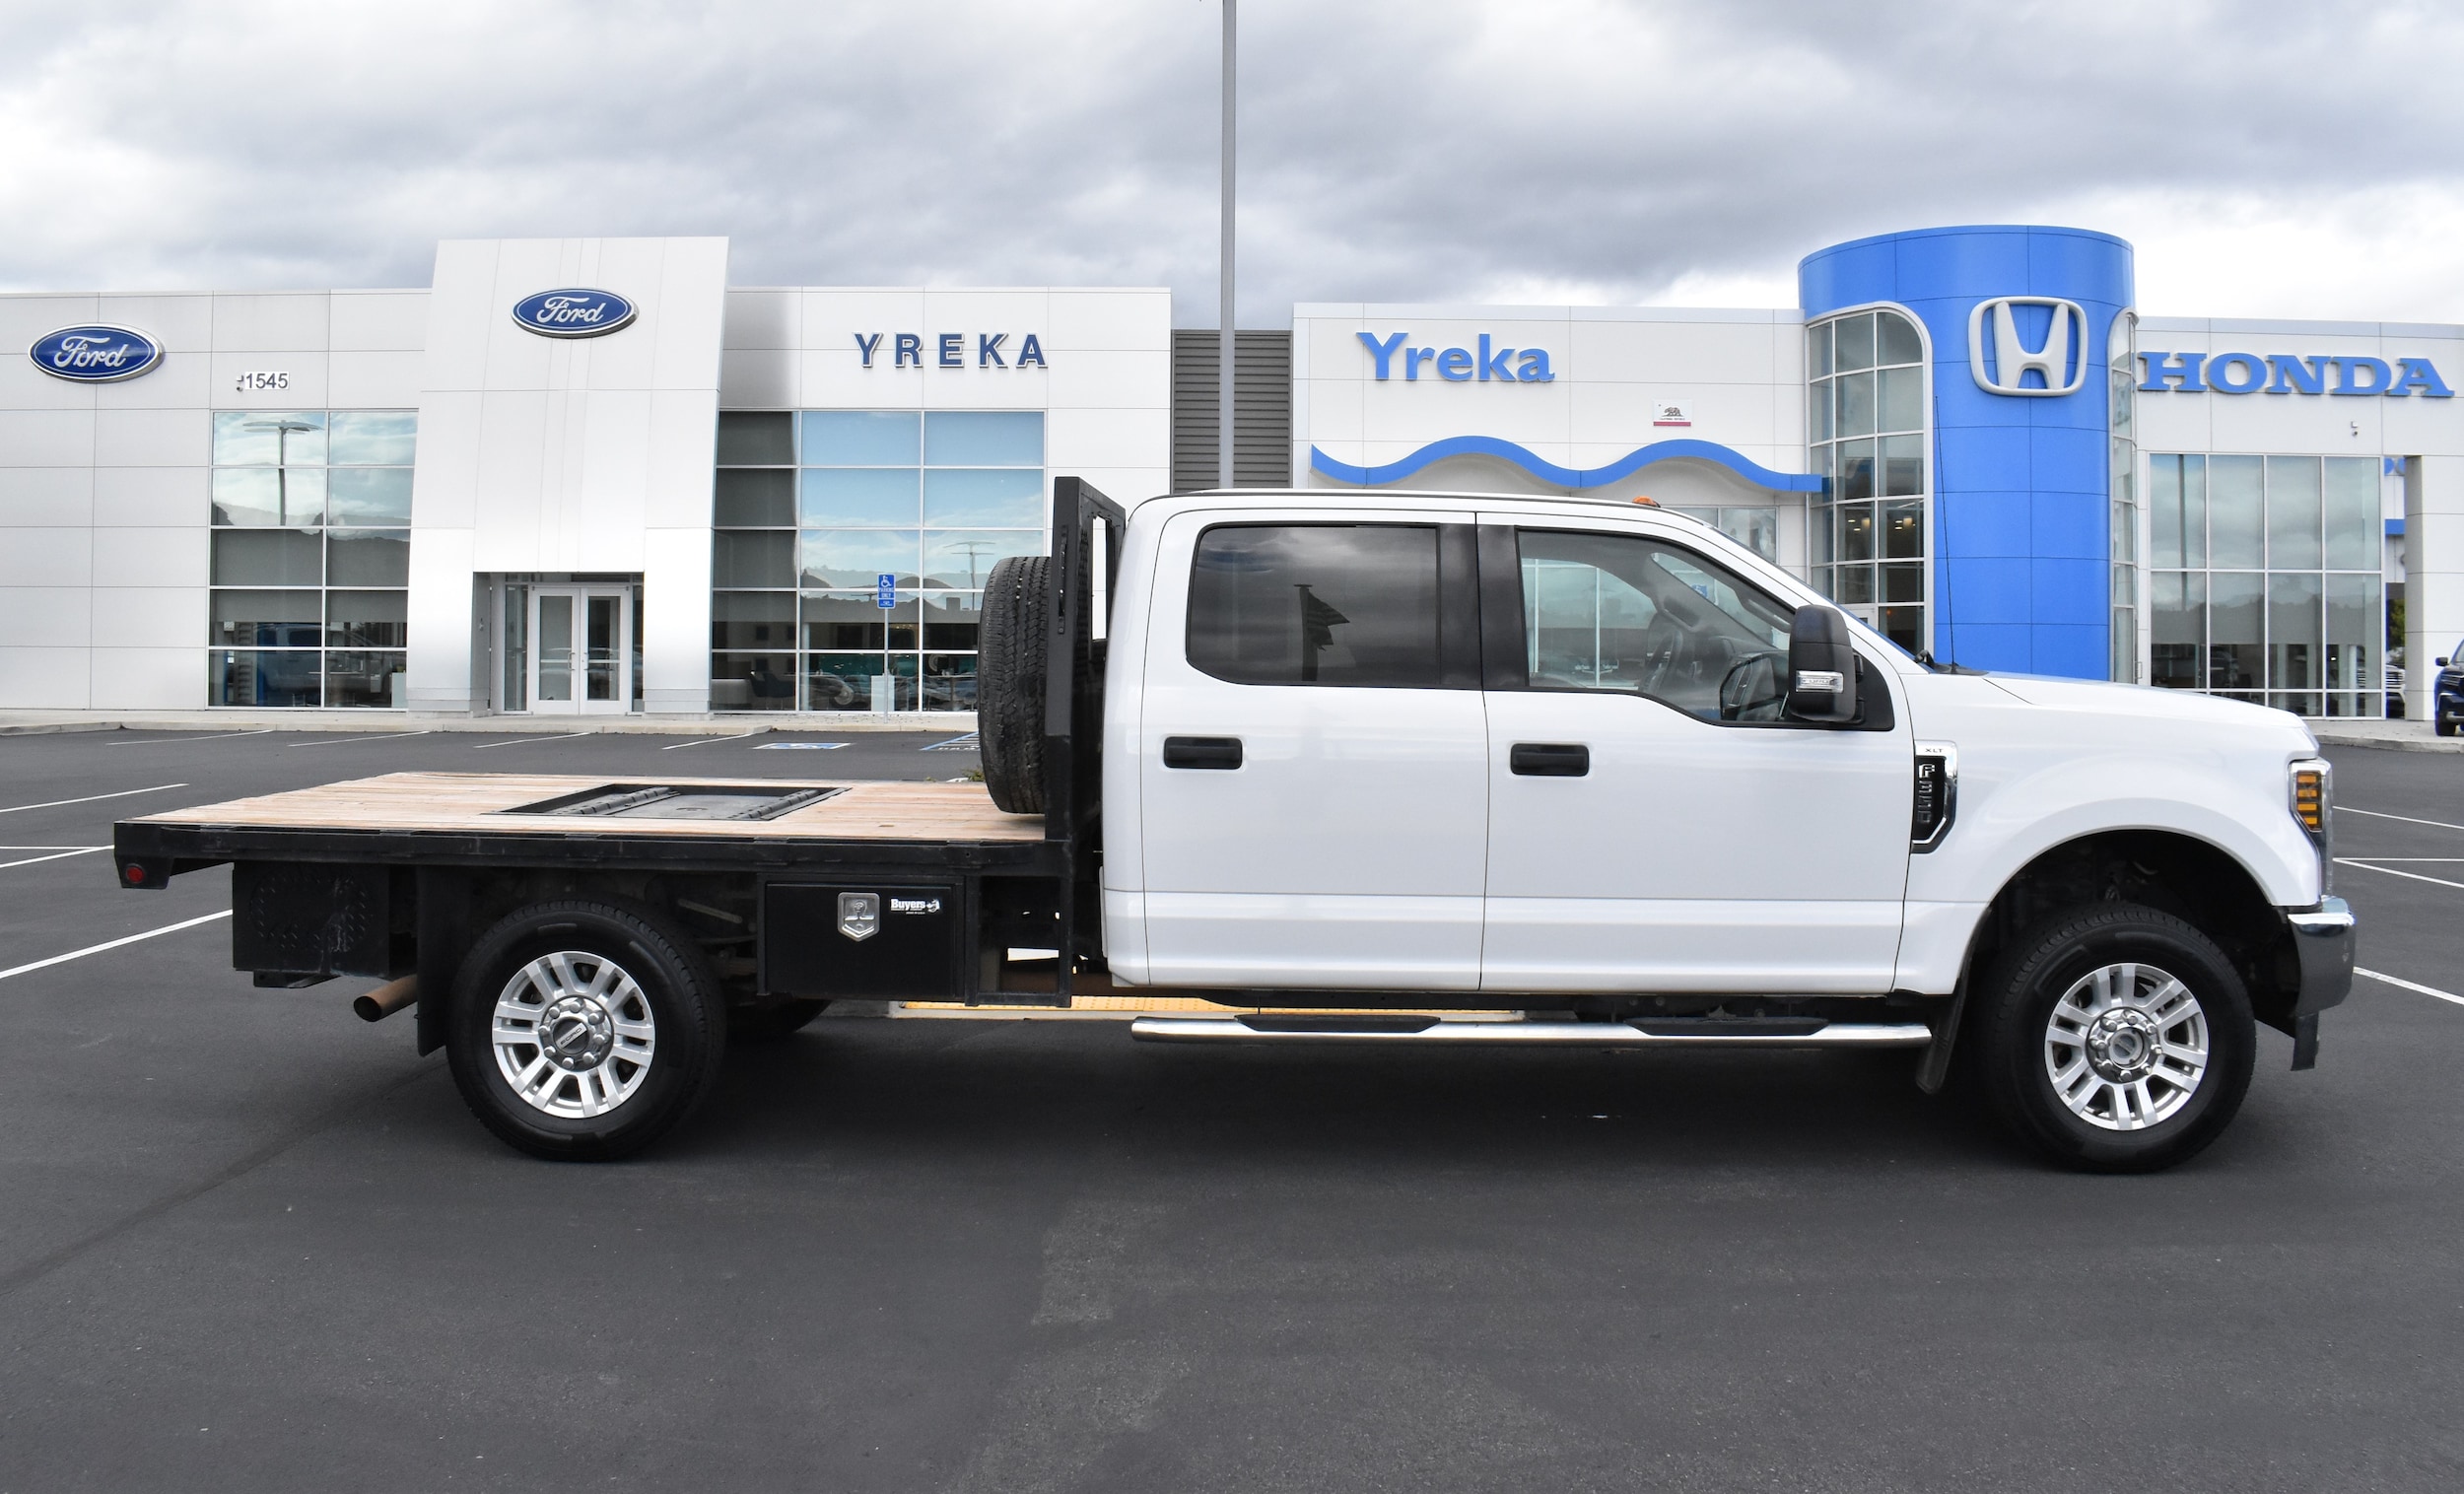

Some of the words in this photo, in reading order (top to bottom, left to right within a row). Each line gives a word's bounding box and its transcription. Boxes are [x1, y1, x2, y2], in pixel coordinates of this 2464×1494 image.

[536, 296, 606, 323] Ford
[53, 335, 129, 368] Ford
[852, 331, 1049, 369] YREKA
[1355, 332, 1555, 382] Yreka
[244, 373, 289, 389] 1545
[2137, 351, 2455, 398] HONDA
[890, 898, 926, 911] Buyers
[560, 1027, 582, 1046] FORD
